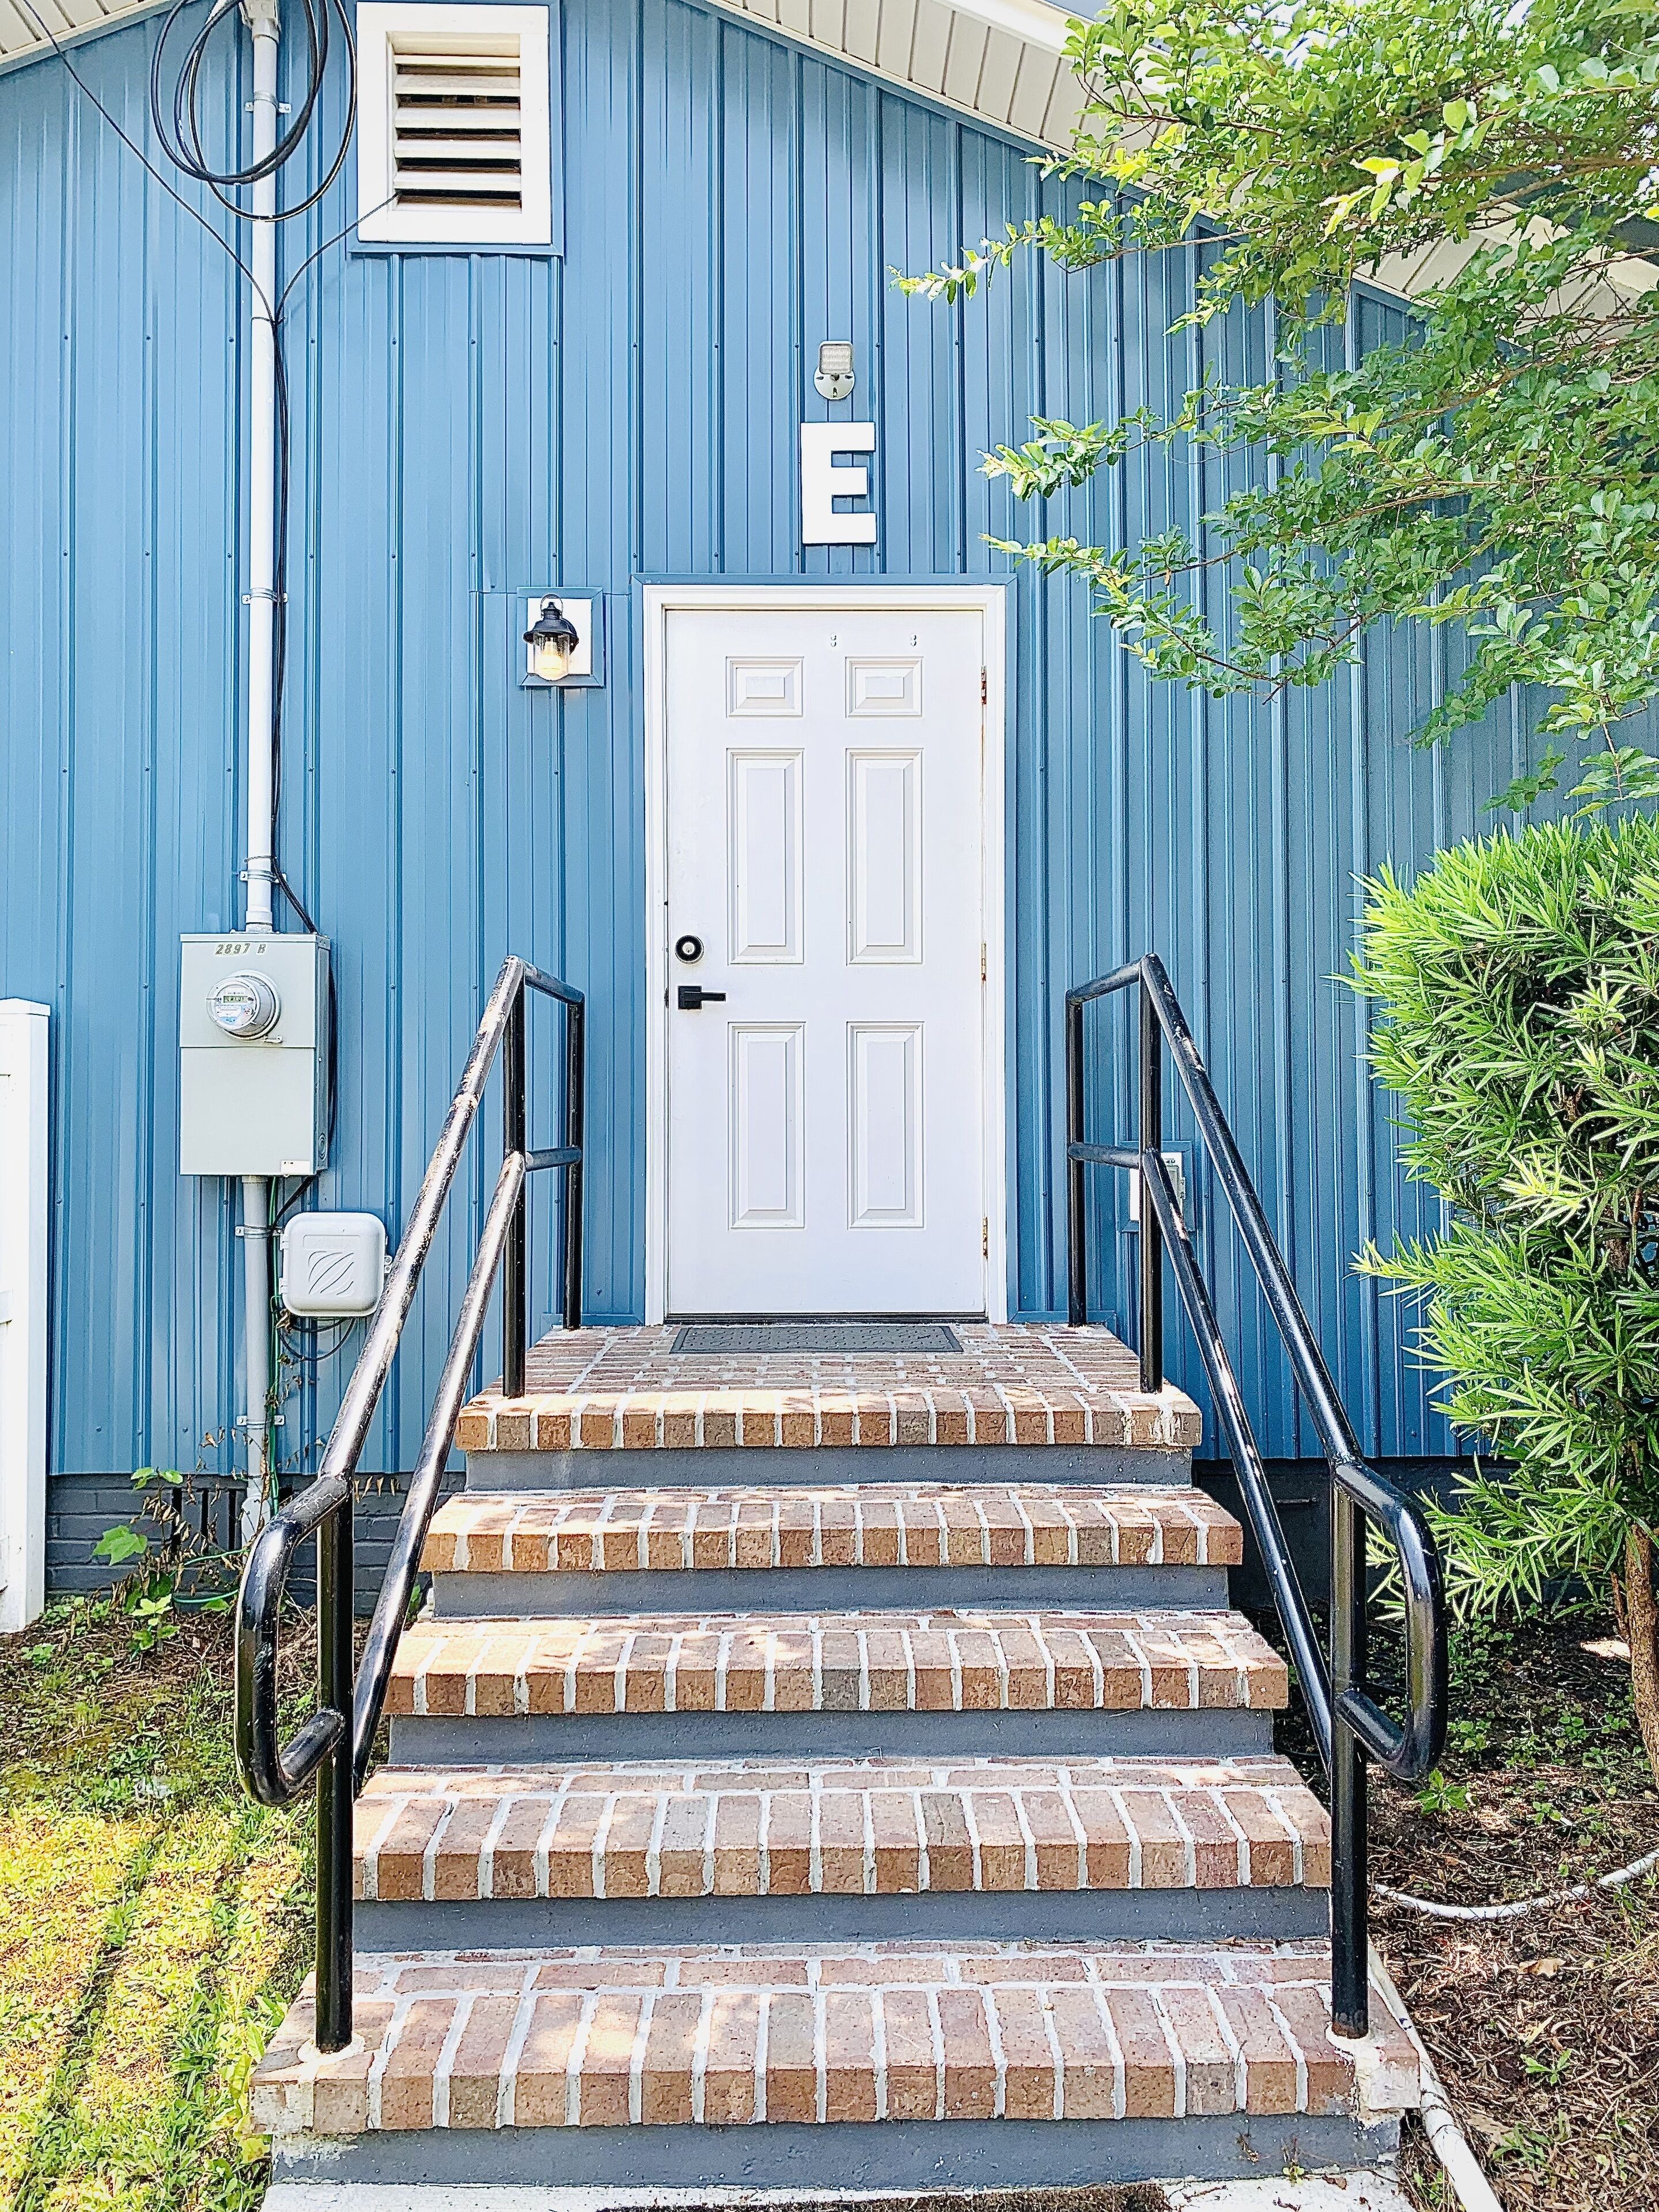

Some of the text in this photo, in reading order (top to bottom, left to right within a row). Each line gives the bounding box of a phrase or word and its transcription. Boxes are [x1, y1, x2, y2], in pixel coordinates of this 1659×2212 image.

[801, 422, 876, 543] E
[215, 943, 266, 955] 2897 B
